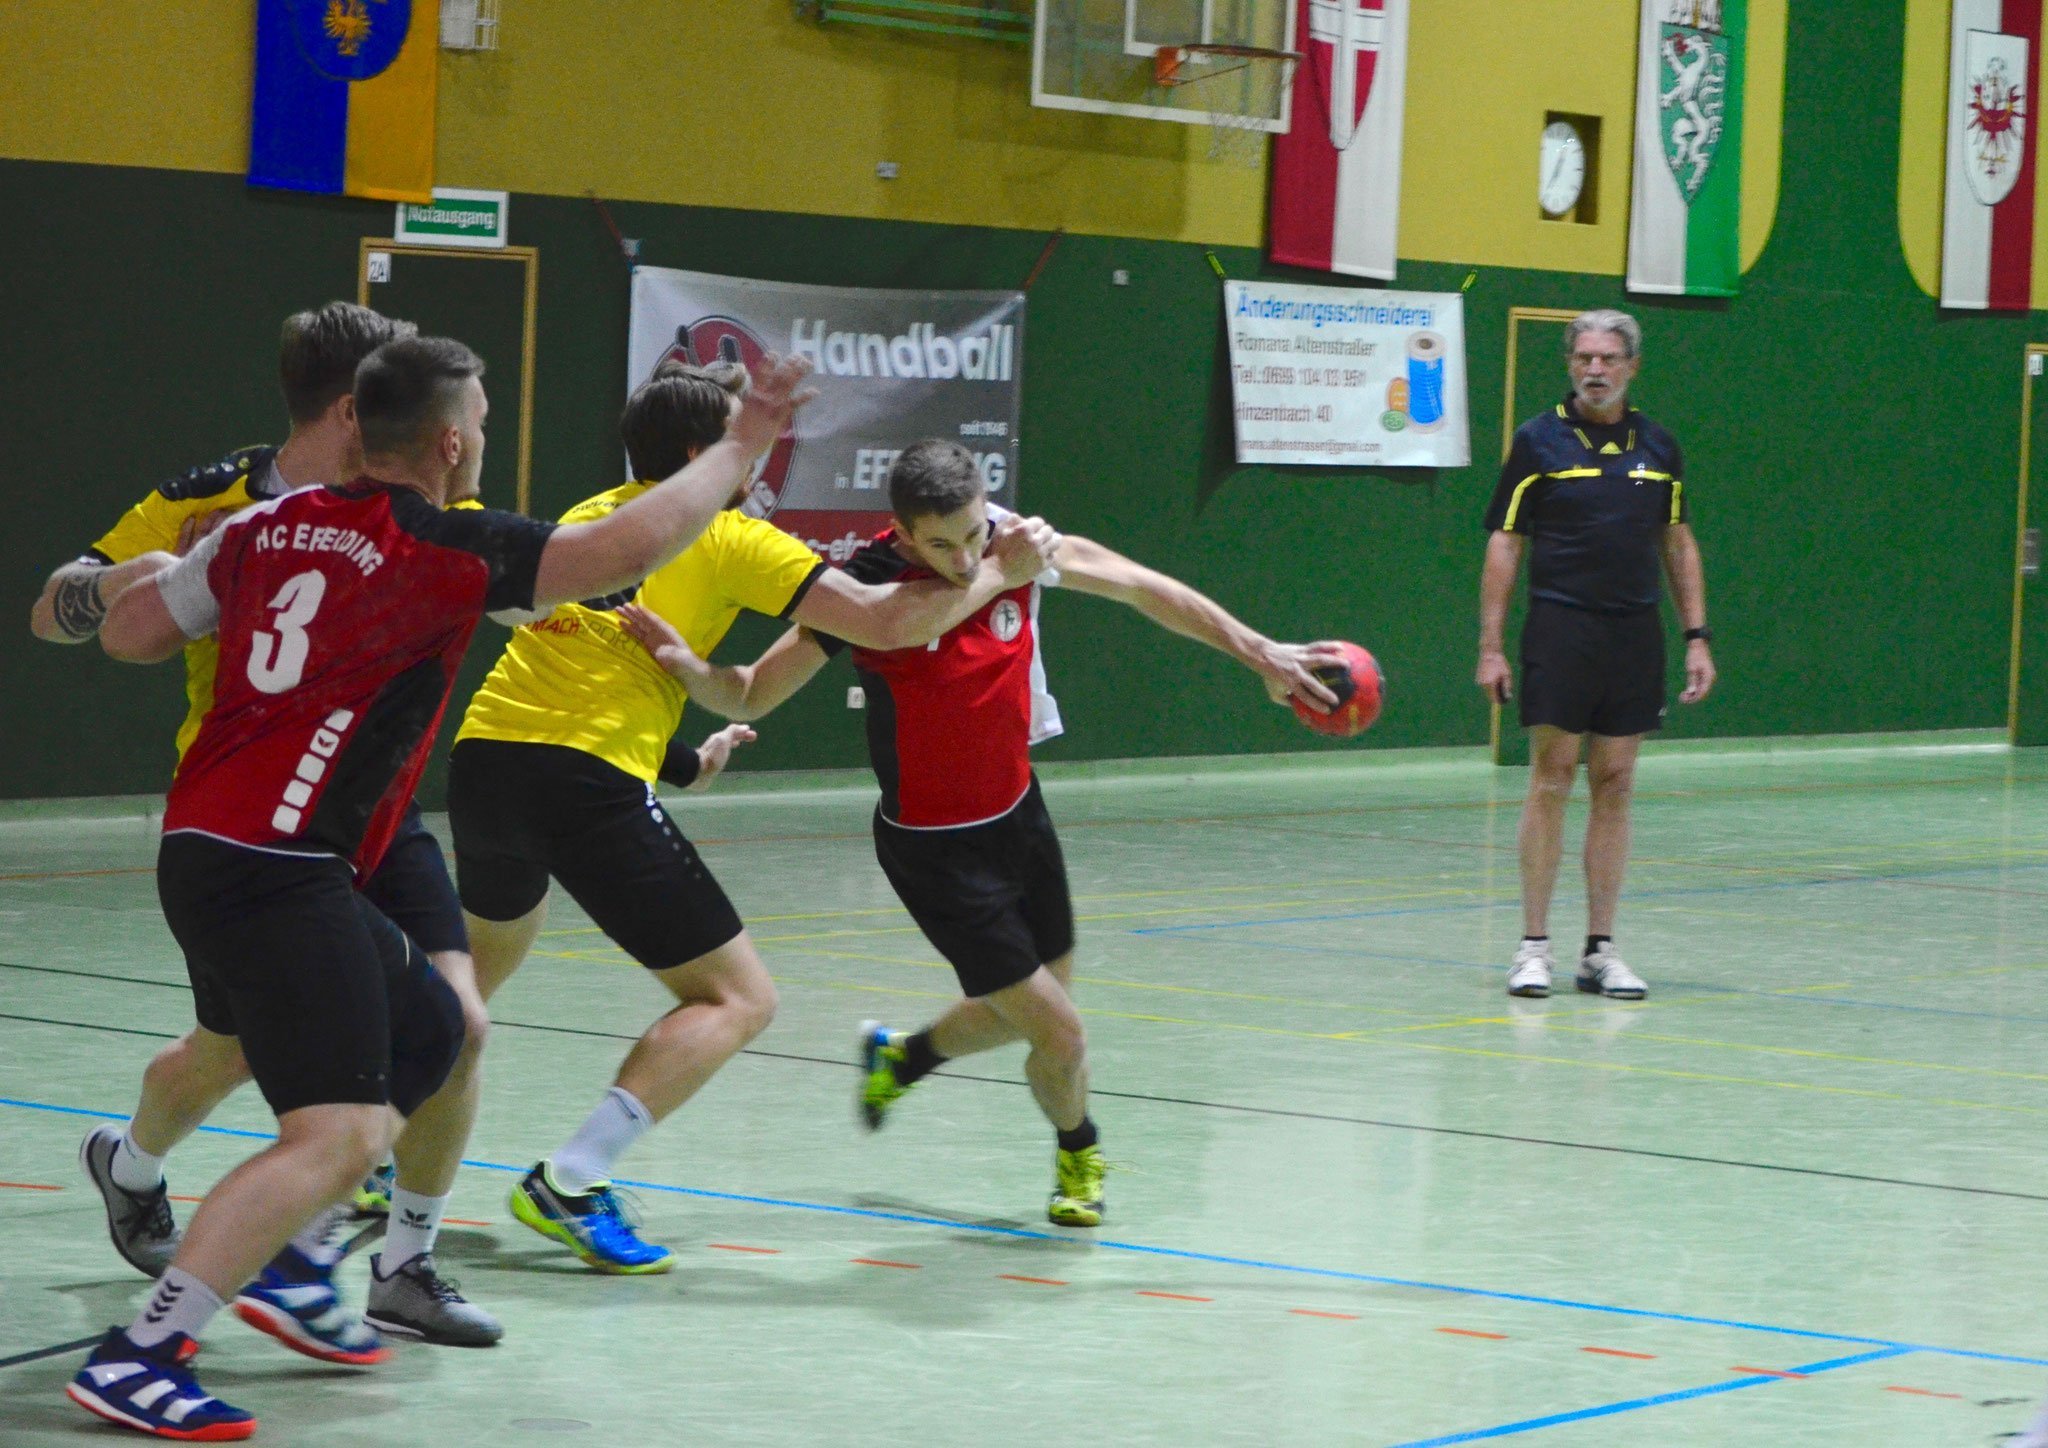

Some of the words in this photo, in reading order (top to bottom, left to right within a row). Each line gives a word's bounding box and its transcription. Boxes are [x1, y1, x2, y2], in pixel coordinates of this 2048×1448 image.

[407, 205, 497, 230] Notausgang
[1235, 287, 1435, 329] Änderungsschneiderei
[791, 316, 1015, 382] Handball
[1235, 331, 1292, 353] Romana
[256, 524, 288, 554] HC
[247, 568, 327, 694] 3
